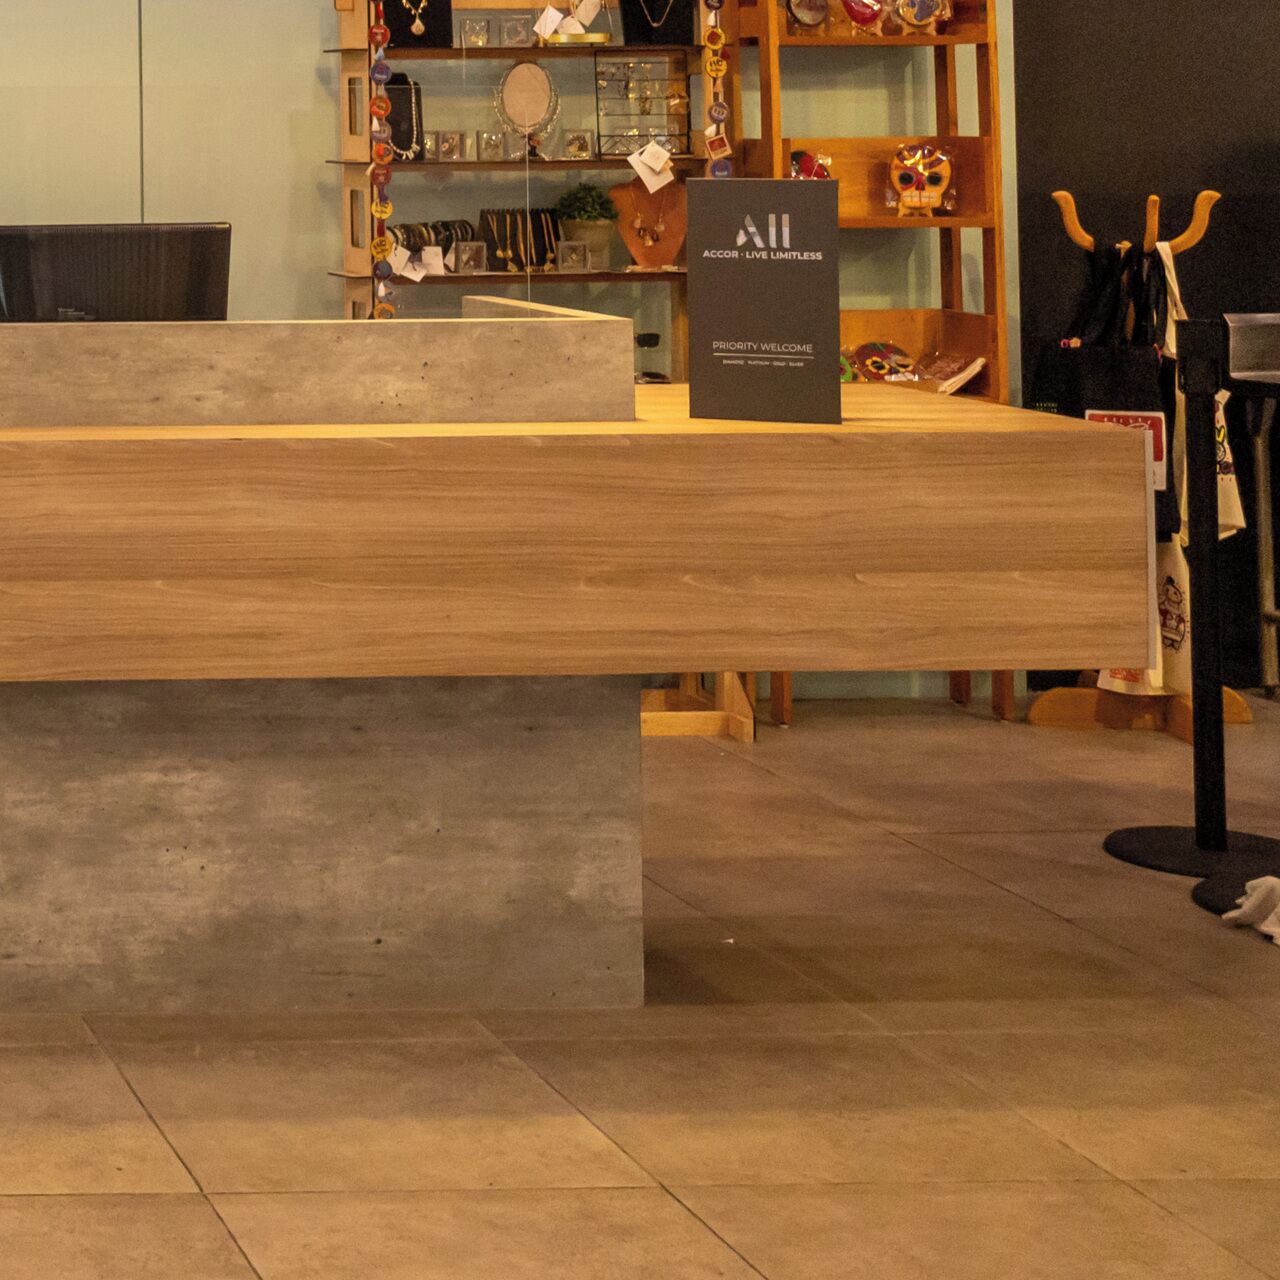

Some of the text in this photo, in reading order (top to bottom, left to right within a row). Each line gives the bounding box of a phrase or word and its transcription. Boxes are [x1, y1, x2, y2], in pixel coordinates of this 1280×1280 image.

[702, 250, 823, 261] ACCOR LIVE LIMITLESS
[712, 341, 813, 353] PRIORITY WELCOME
